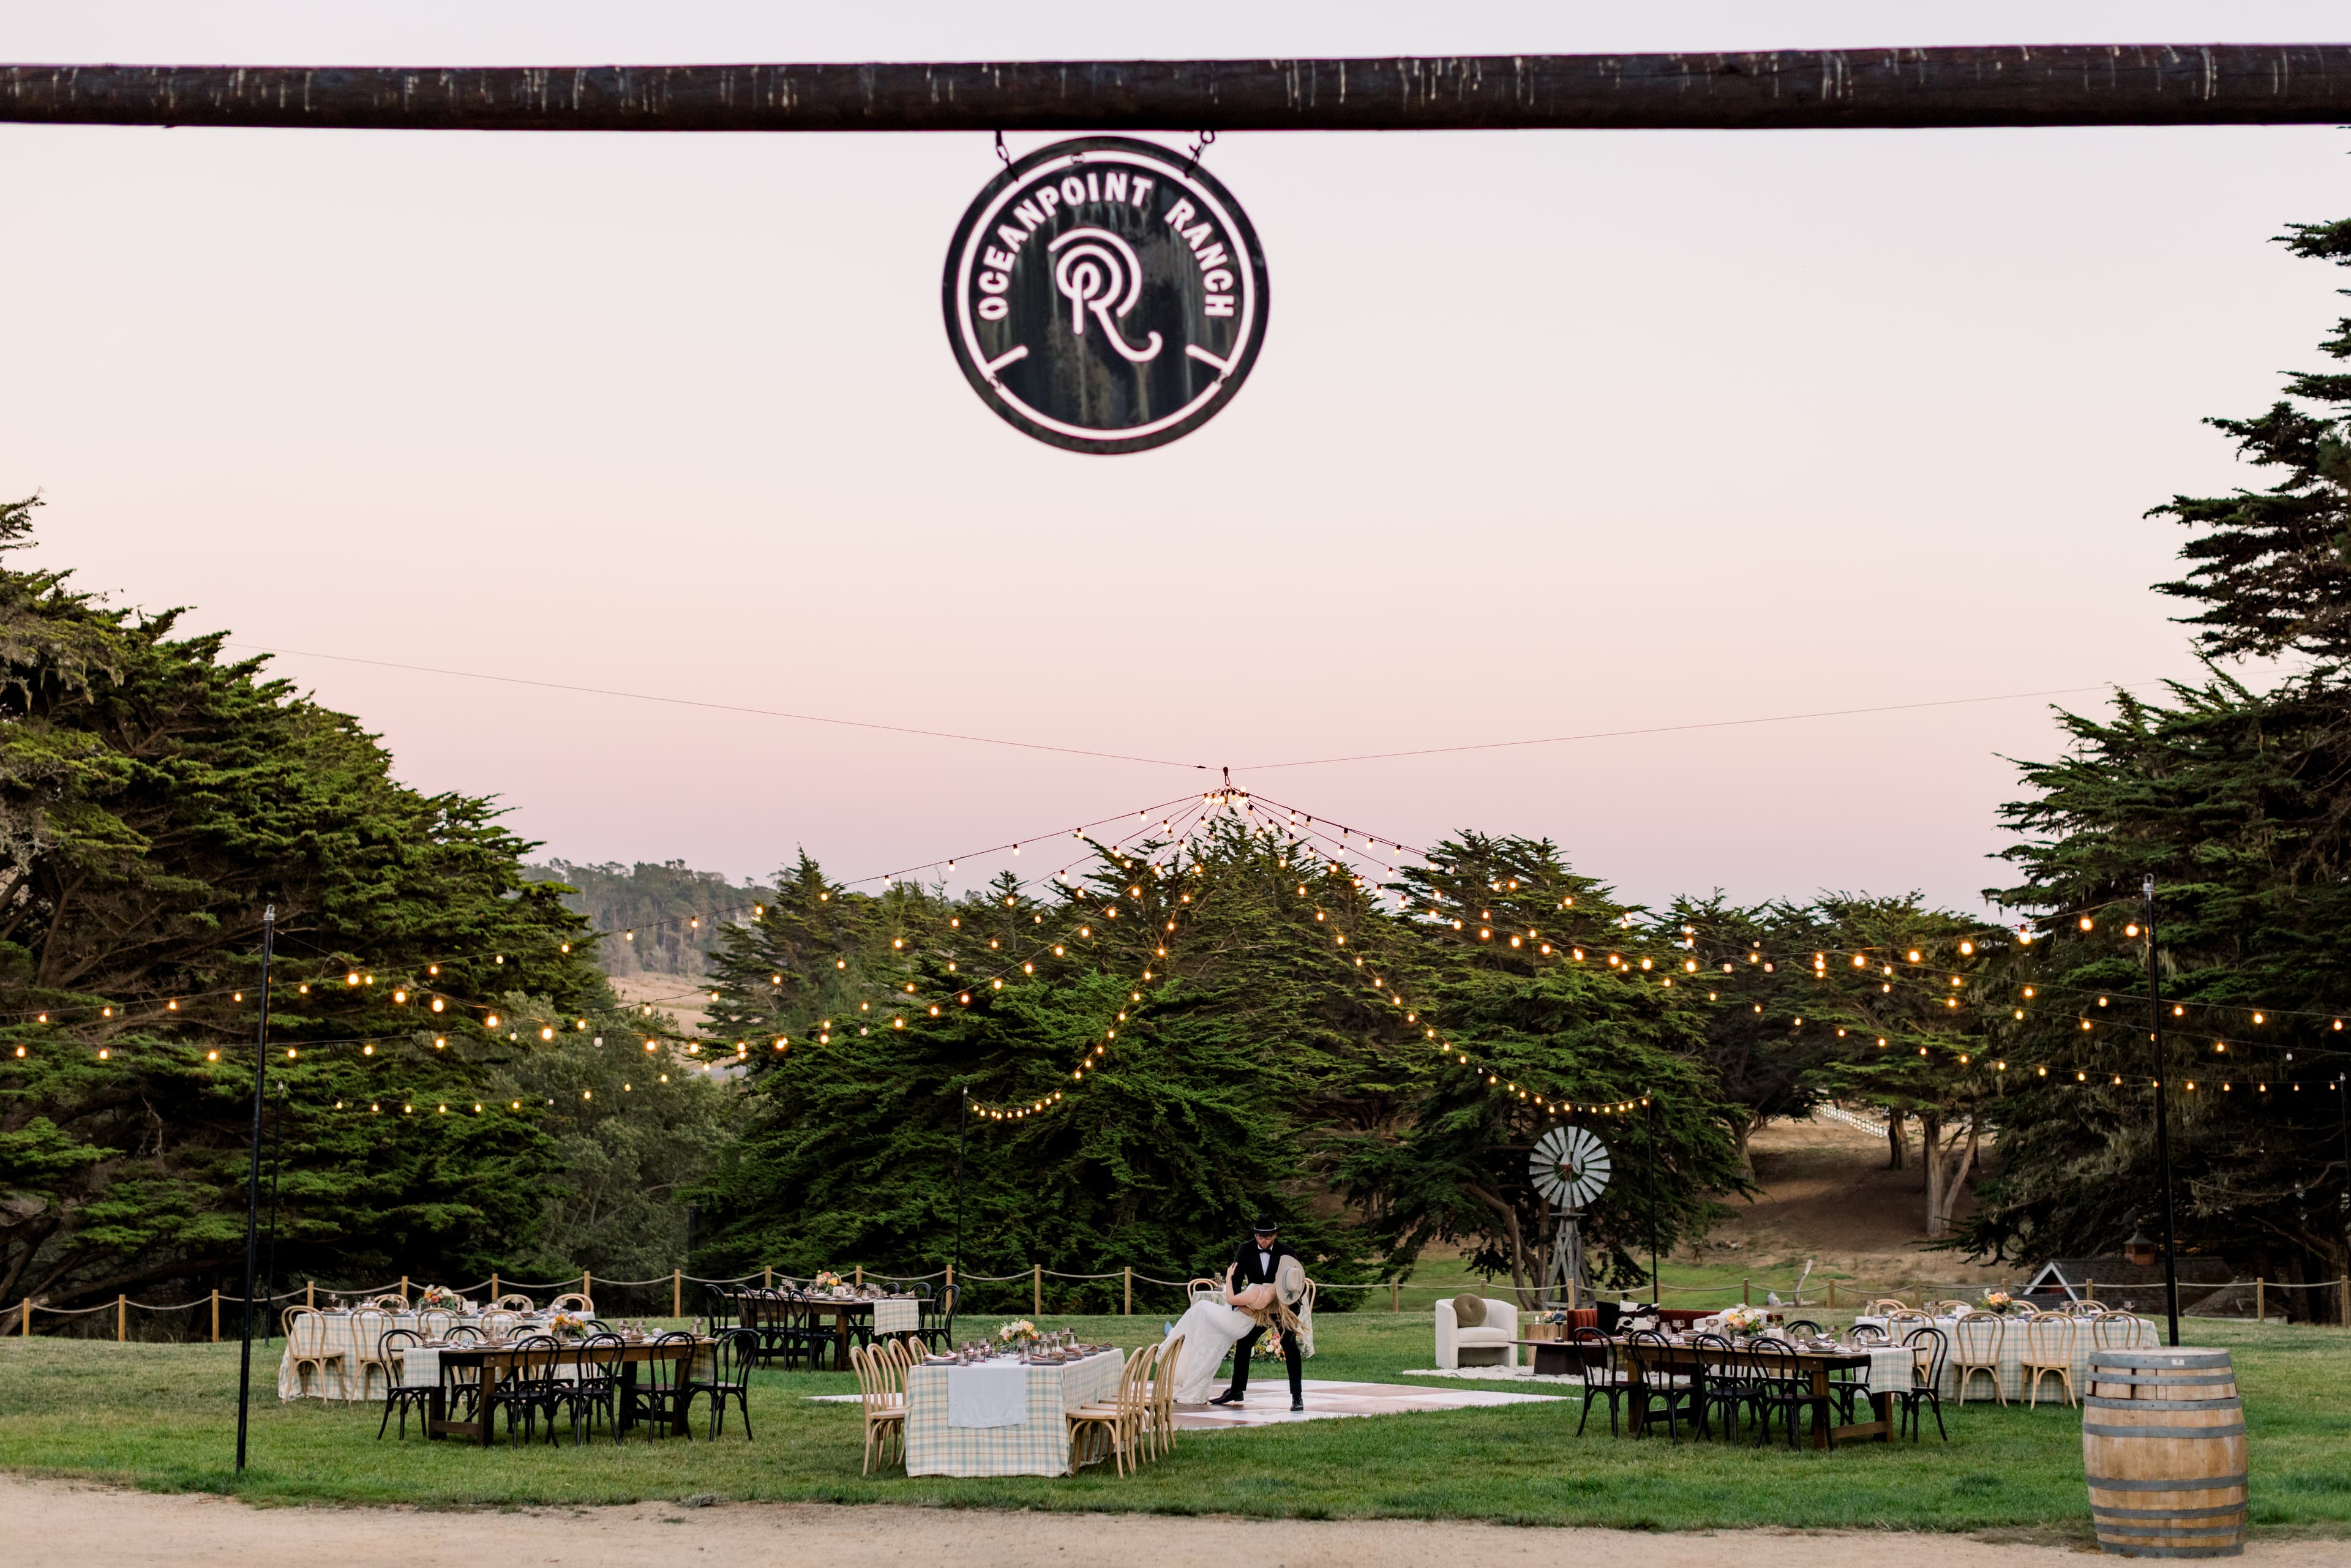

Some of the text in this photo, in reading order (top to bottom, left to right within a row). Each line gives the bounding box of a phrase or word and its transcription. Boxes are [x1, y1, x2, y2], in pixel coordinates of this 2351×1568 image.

[978, 172, 1235, 320] OCEANPOINT RANCH
[1048, 228, 1163, 362] R
